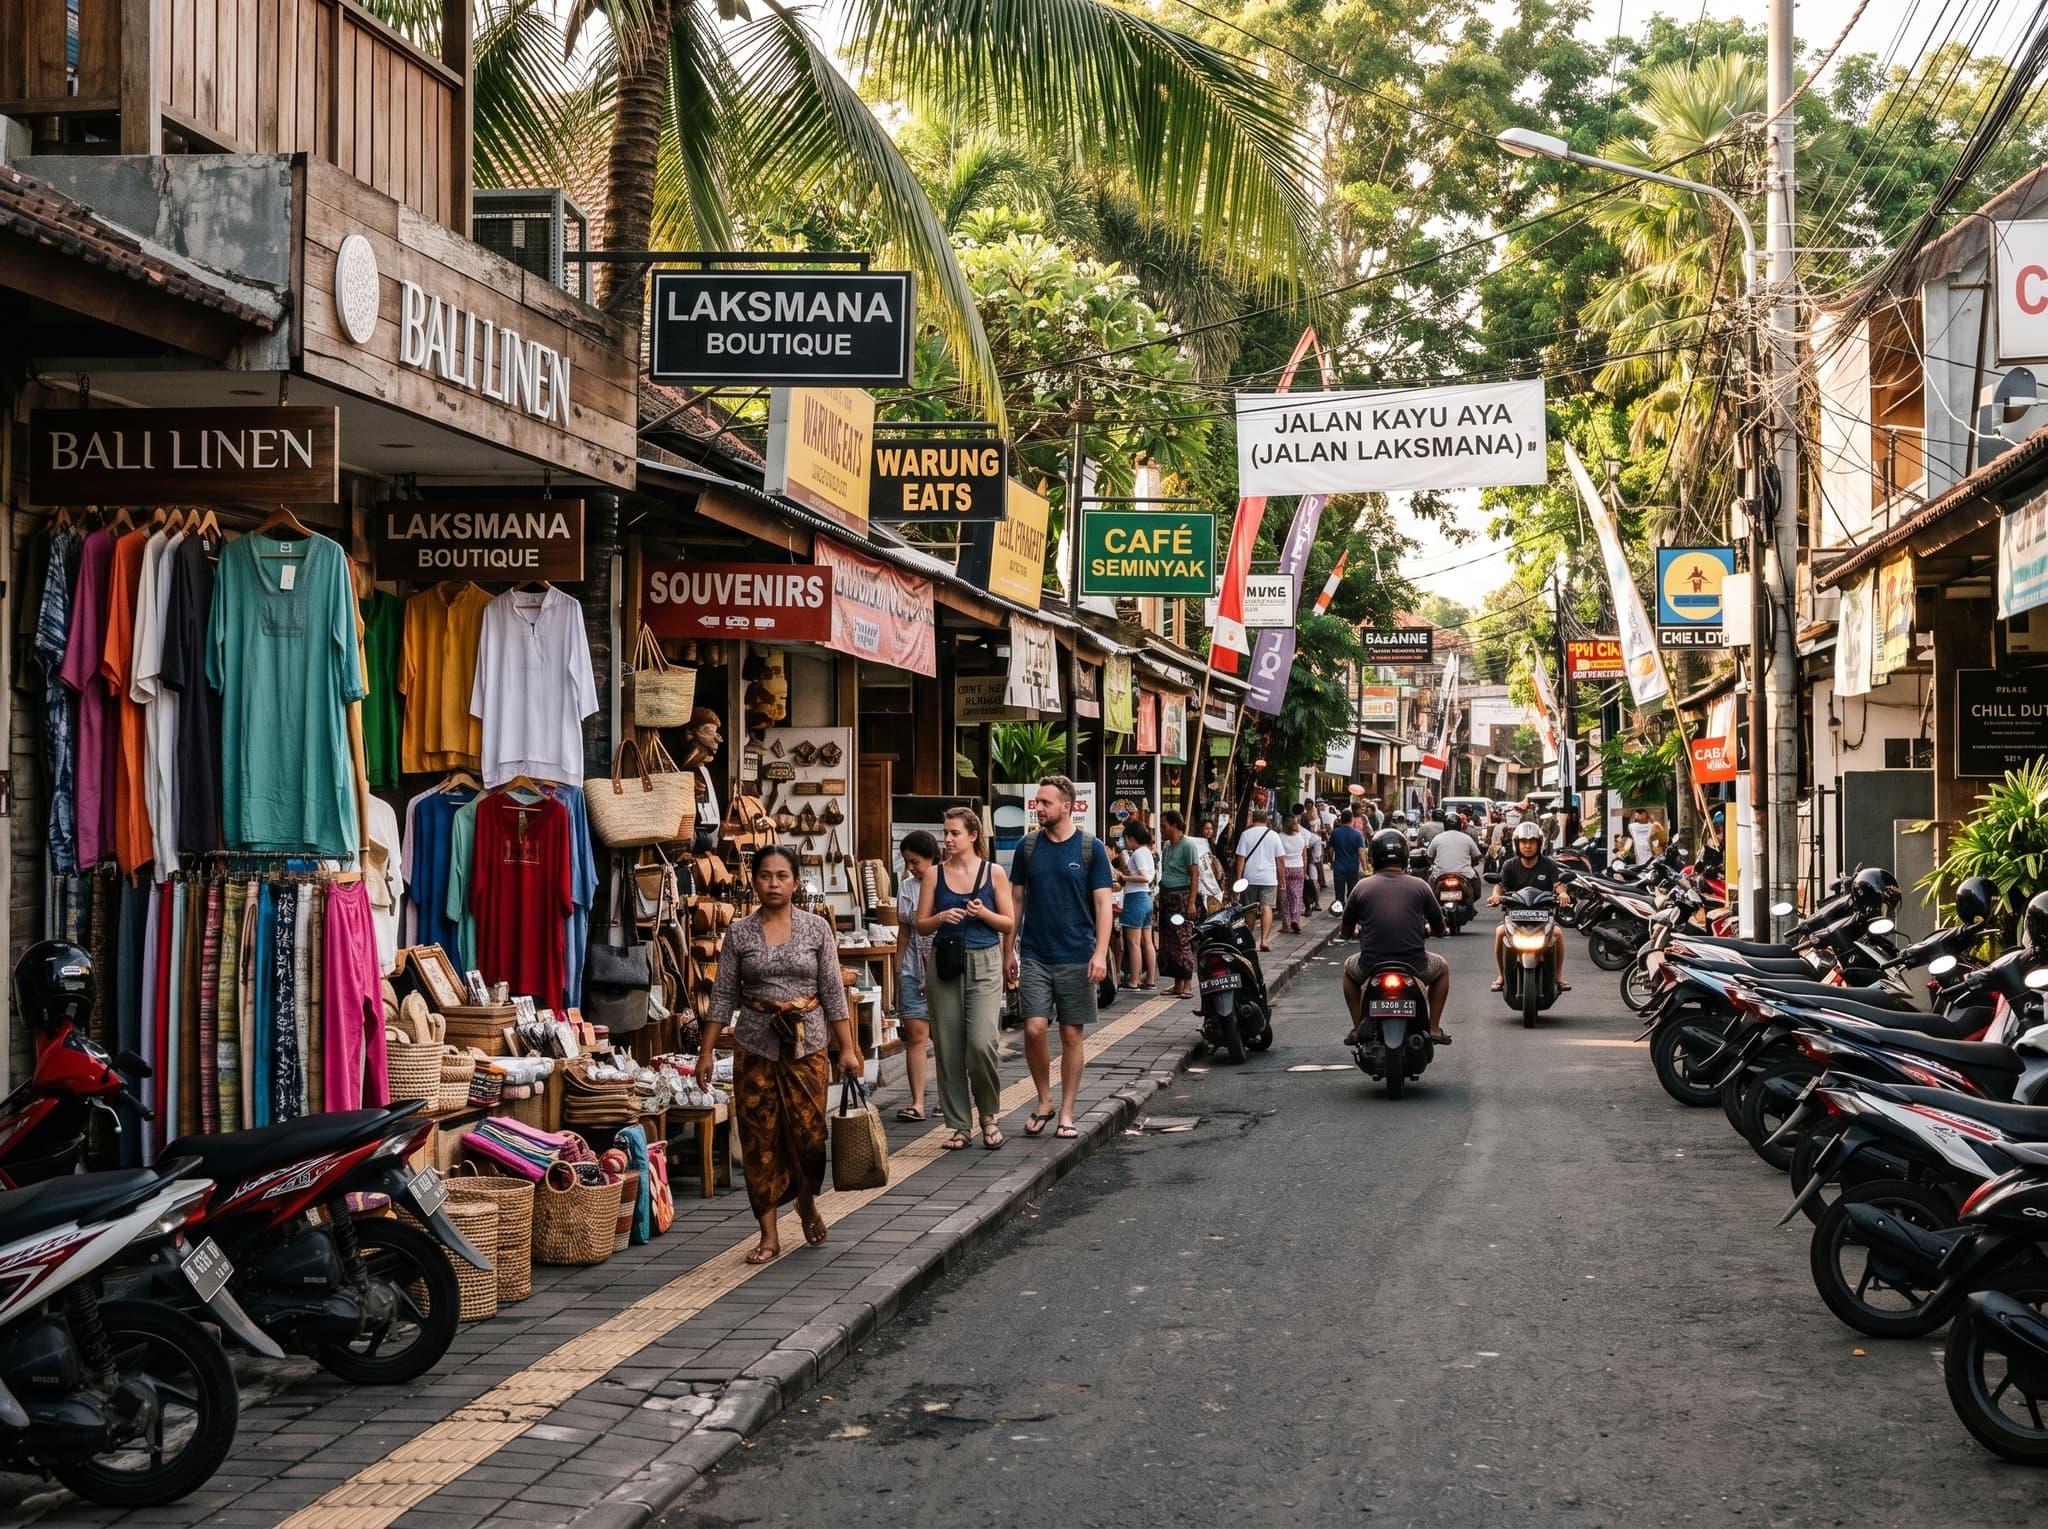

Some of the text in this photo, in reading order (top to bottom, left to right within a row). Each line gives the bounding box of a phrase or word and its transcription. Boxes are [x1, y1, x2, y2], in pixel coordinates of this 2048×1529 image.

[667, 291, 893, 324] LAKSMANA
[399, 278, 570, 428] BALI LINEN
[706, 332, 852, 357] BOUTIQUE
[1275, 403, 1513, 434] JALAN KAYU AYA
[50, 428, 313, 471] BALI LINEN
[876, 448, 1000, 477] WARUNG
[1251, 432, 1523, 469] (JALAN LAKSMANA)
[902, 483, 972, 511] EATS
[387, 512, 570, 540] LAKSMANA
[1104, 524, 1193, 554] CAFÉ
[417, 548, 540, 569] BOUTIQUE
[1091, 558, 1206, 578] SEMINYAK
[649, 571, 824, 608] SOUVENIRS
[1971, 704, 2016, 717] CHILL
